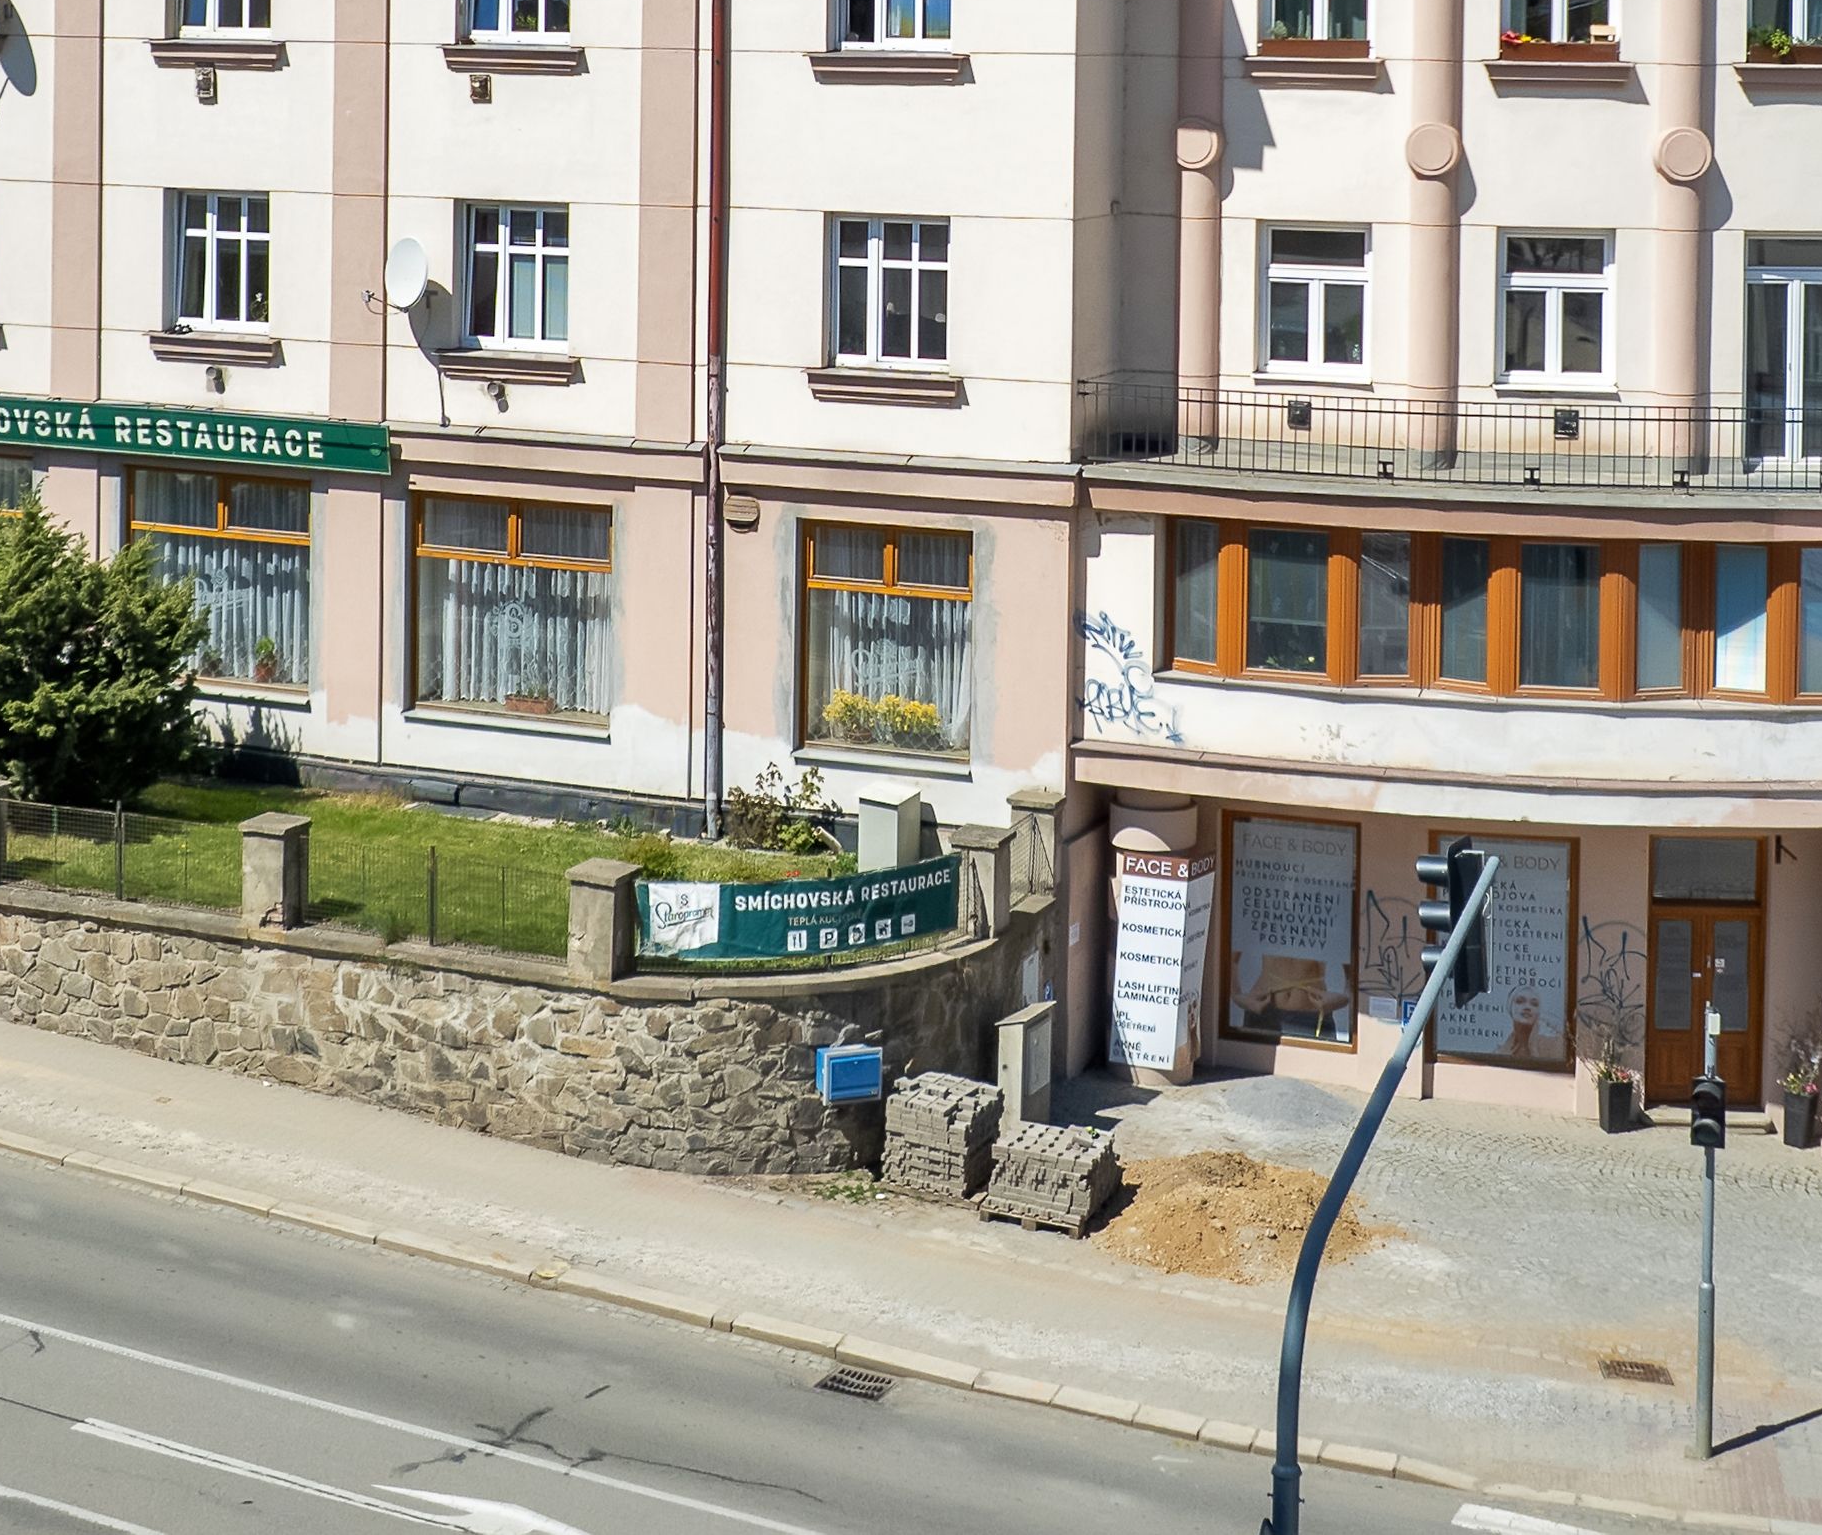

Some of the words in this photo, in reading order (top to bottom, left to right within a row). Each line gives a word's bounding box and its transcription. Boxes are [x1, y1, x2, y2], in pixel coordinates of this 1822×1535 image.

[114, 415, 325, 460] RESTAURACE
[1242, 833, 1283, 851] FACE
[1287, 838, 1297, 851] &
[1302, 840, 1347, 856] BODY
[1125, 856, 1173, 877] FACE
[1177, 863, 1189, 878] &
[1191, 856, 1216, 876] BODY
[1235, 859, 1305, 874] HUBNOUCÍ
[1513, 856, 1561, 872] BODY
[735, 886, 855, 912] SMÍCHOVSKÁ
[861, 869, 952, 901] RESTAURACE
[1124, 885, 1182, 900] ESTETICKÁ
[788, 914, 817, 927] TEPLÁ
[1259, 933, 1327, 950] POSTAVY
[1120, 951, 1181, 967] KOSMETICK
[1118, 980, 1145, 991] LASH
[1147, 983, 1182, 996] LIFTIN
[1117, 990, 1170, 1005] LAMINACE
[1116, 1010, 1131, 1021] IPL
[1440, 1012, 1476, 1024] AKNÉ
[1115, 1020, 1156, 1033] OŠETŘENÍ
